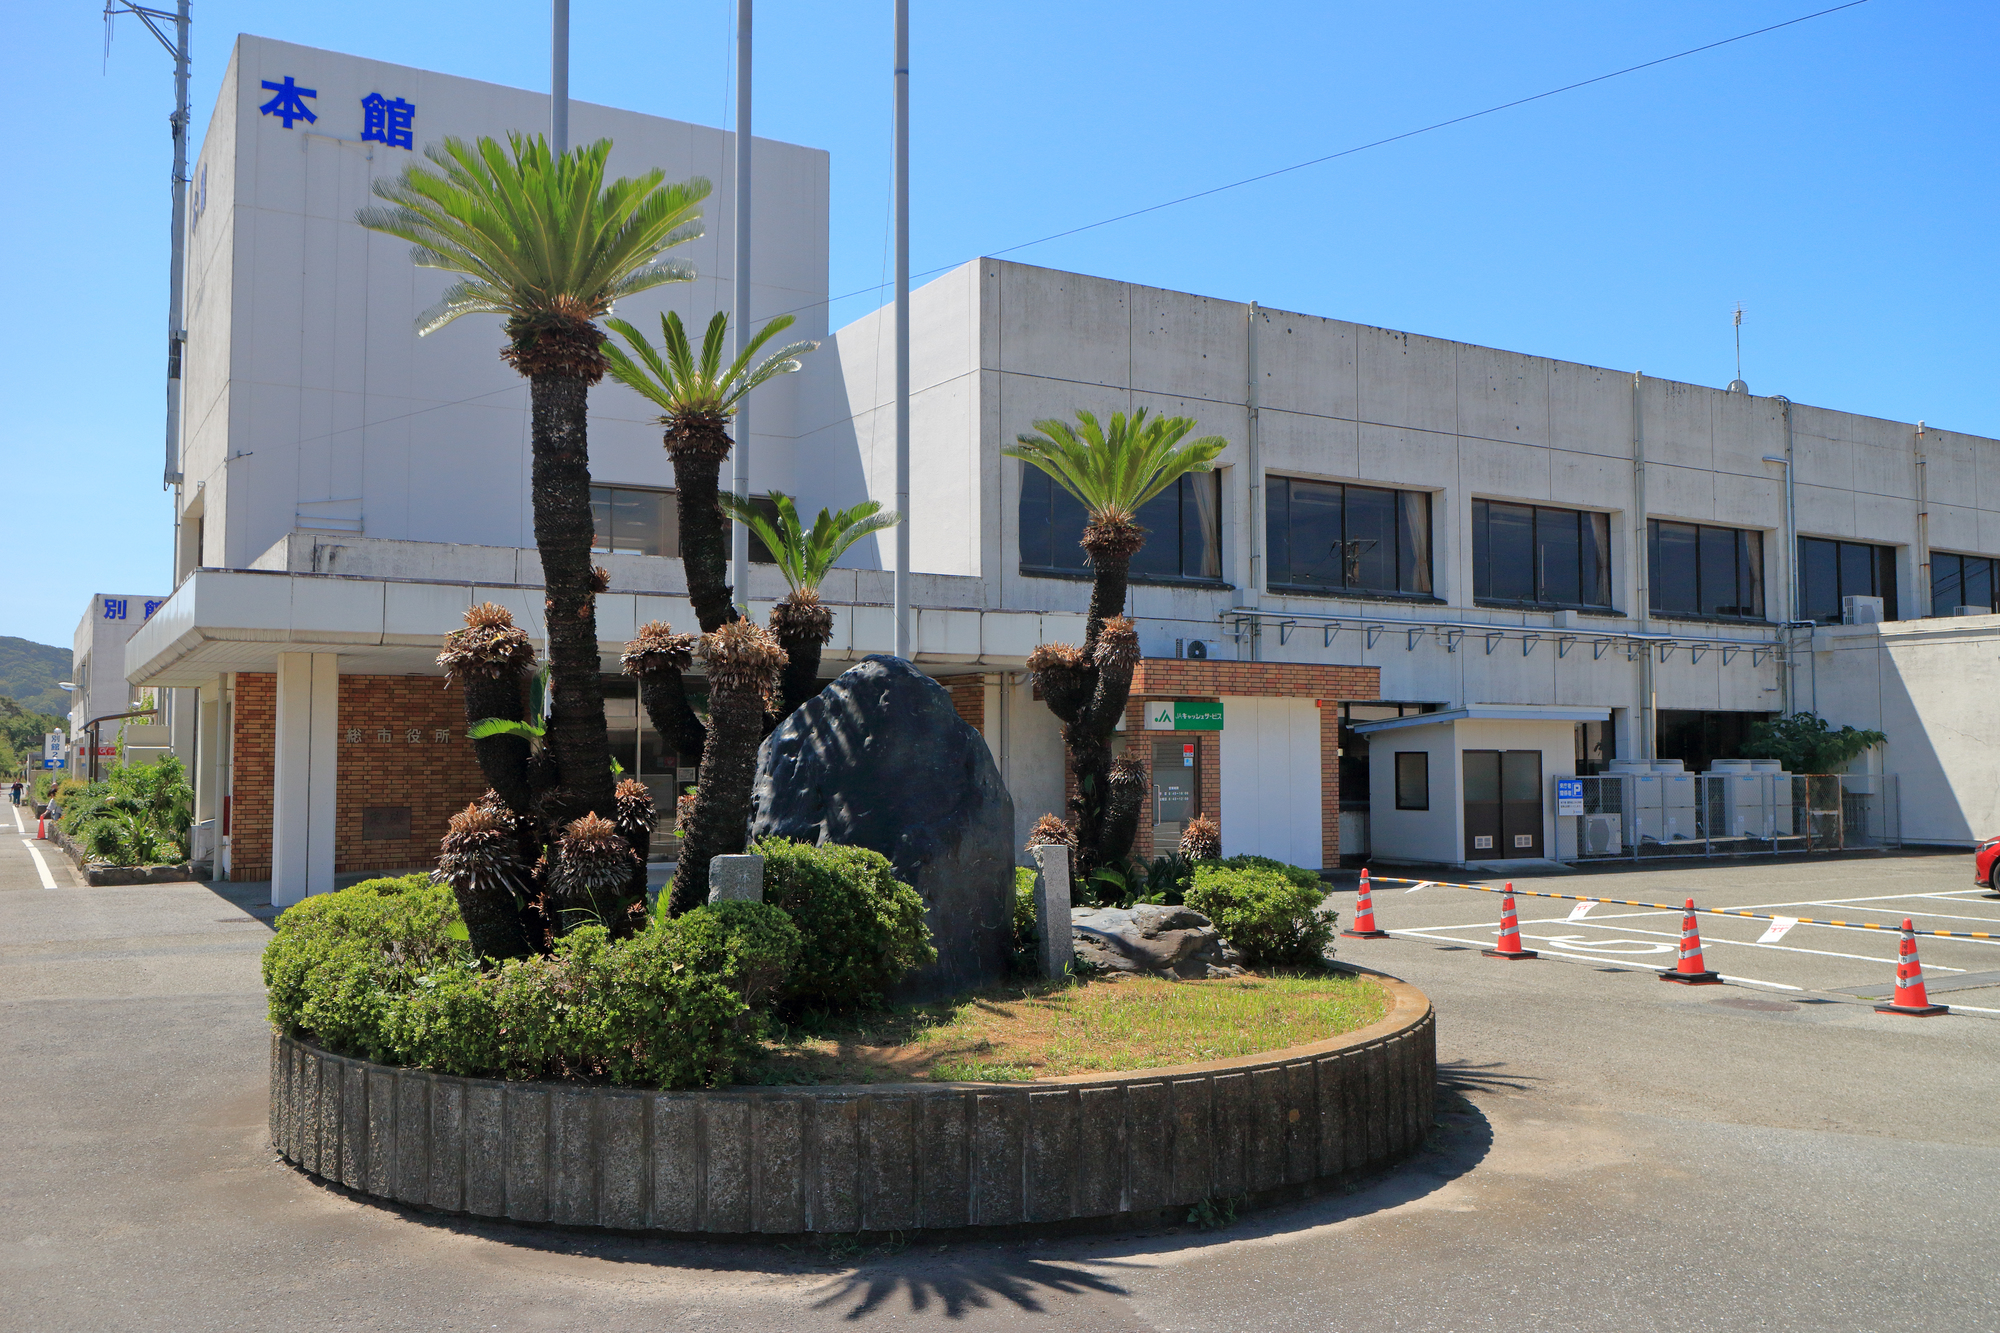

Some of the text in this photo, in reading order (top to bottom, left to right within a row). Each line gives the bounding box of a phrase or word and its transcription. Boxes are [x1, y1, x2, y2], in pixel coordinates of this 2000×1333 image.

[259, 76, 415, 151] 本館
[346, 728, 450, 744] 総市役所
[1574, 784, 1581, 795] P
